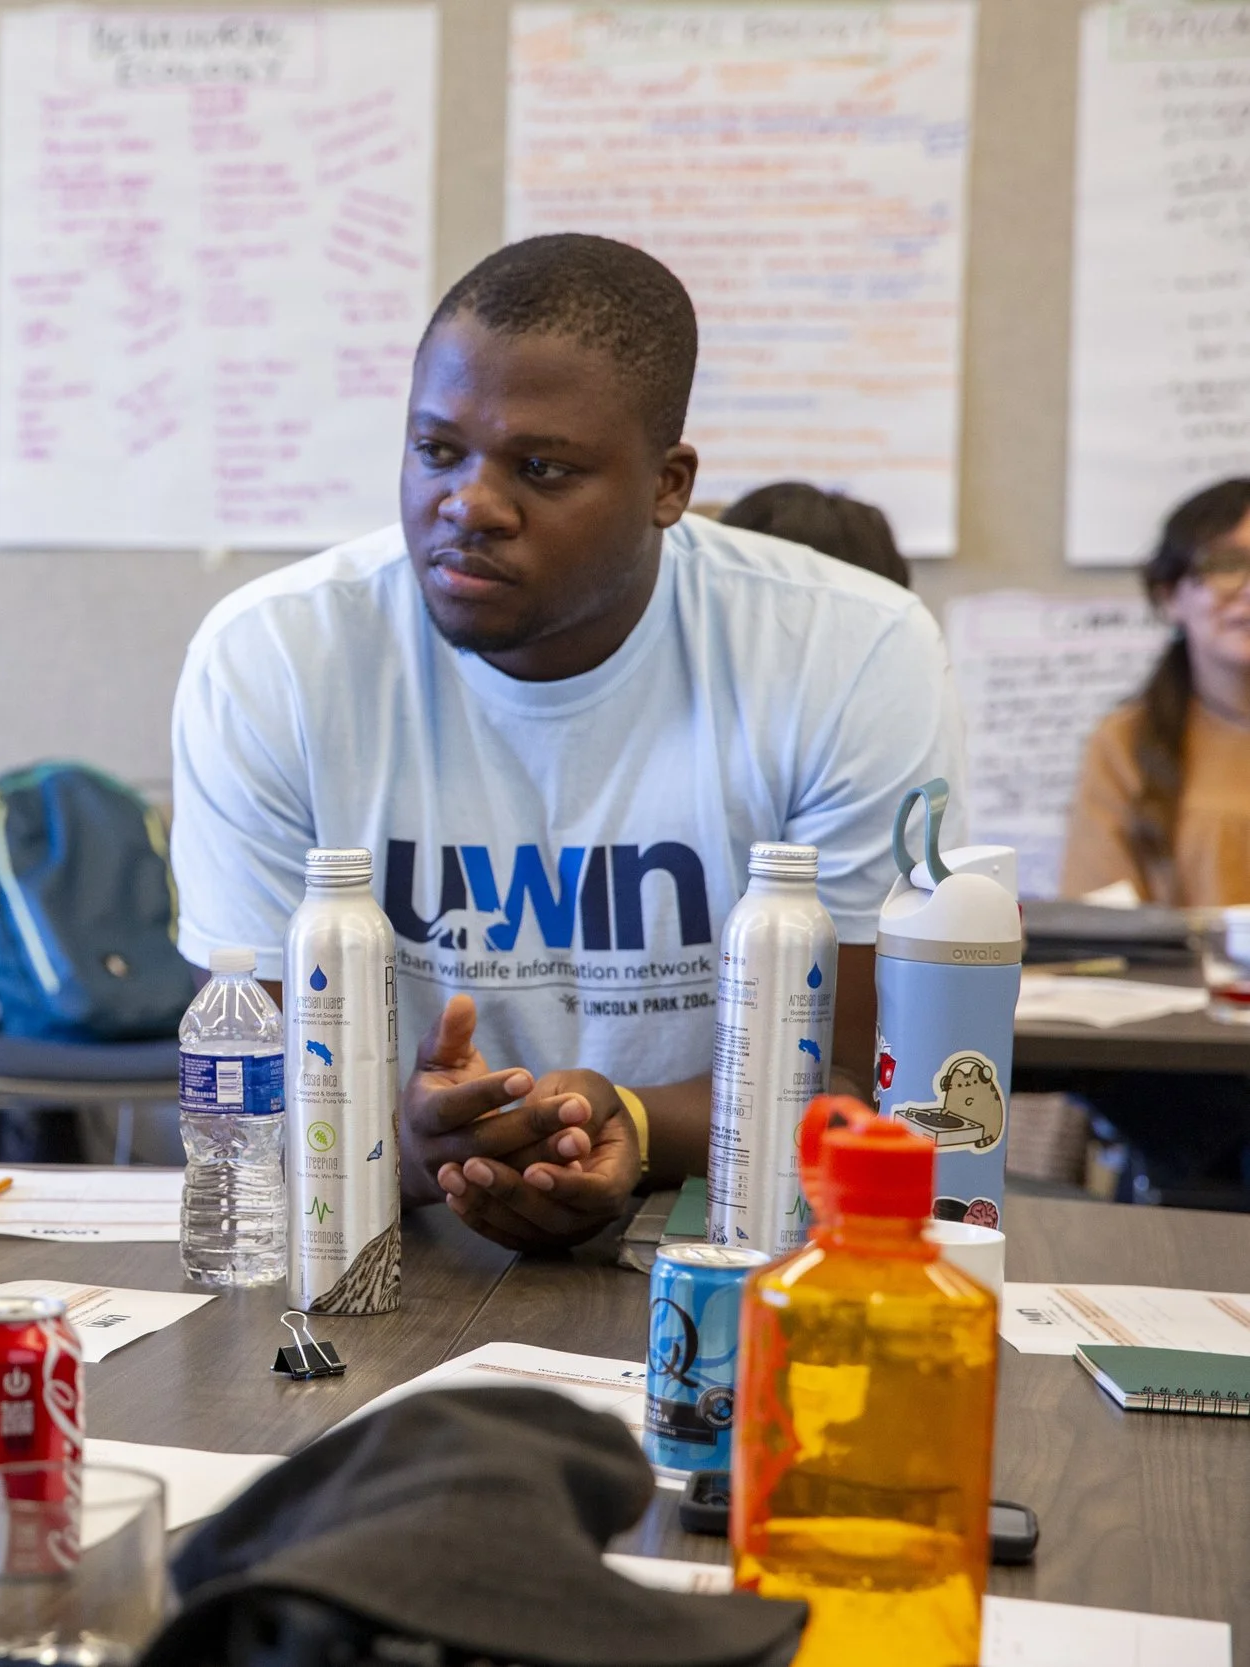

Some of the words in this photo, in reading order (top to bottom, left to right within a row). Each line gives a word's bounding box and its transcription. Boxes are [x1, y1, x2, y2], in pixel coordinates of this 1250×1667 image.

[398, 950, 434, 972] ban
[439, 959, 511, 979] wildlife
[516, 958, 618, 980] information
[624, 955, 712, 980] network
[952, 945, 1001, 961] owala
[584, 999, 638, 1016] LINCOLN
[643, 996, 678, 1014] PARK
[648, 1298, 699, 1389] Q
